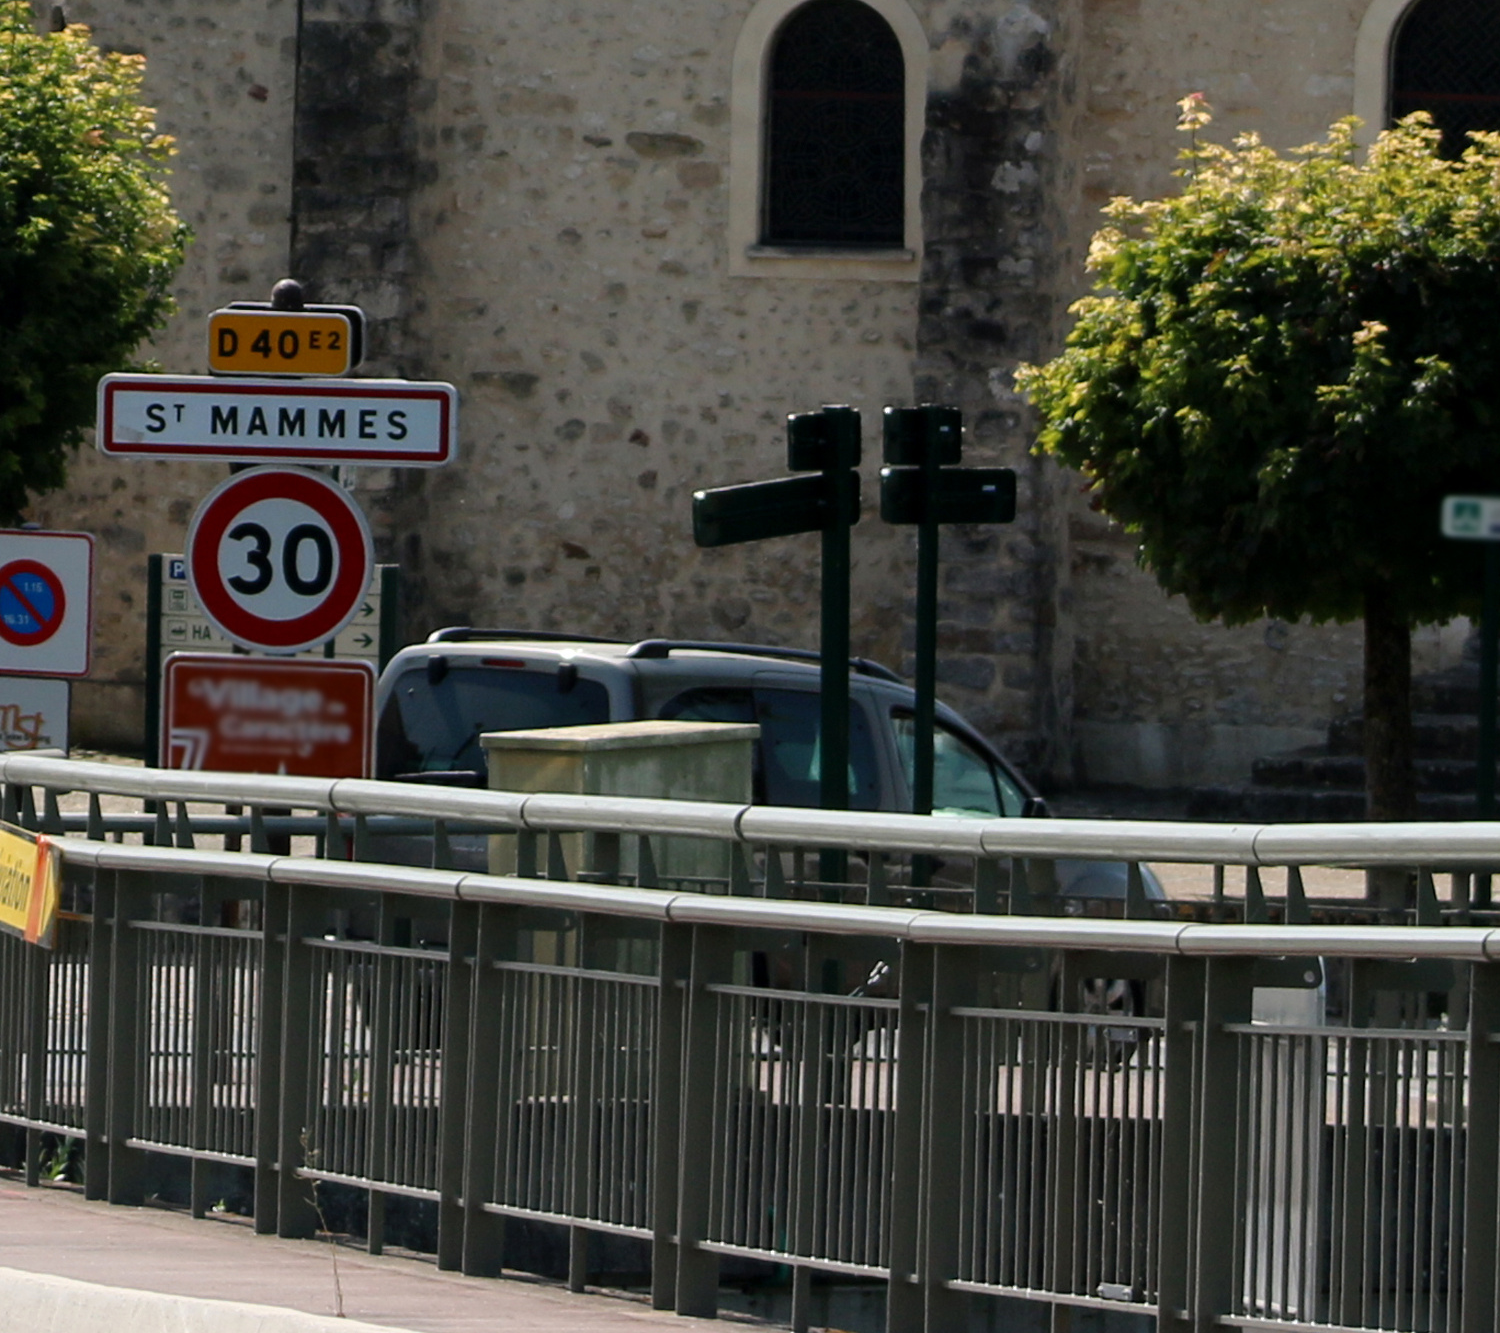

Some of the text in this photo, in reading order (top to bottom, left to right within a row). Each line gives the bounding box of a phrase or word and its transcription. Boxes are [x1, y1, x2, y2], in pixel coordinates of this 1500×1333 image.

[217, 327, 239, 357] D
[210, 405, 409, 441] MAMMES
[227, 522, 333, 596] 30
